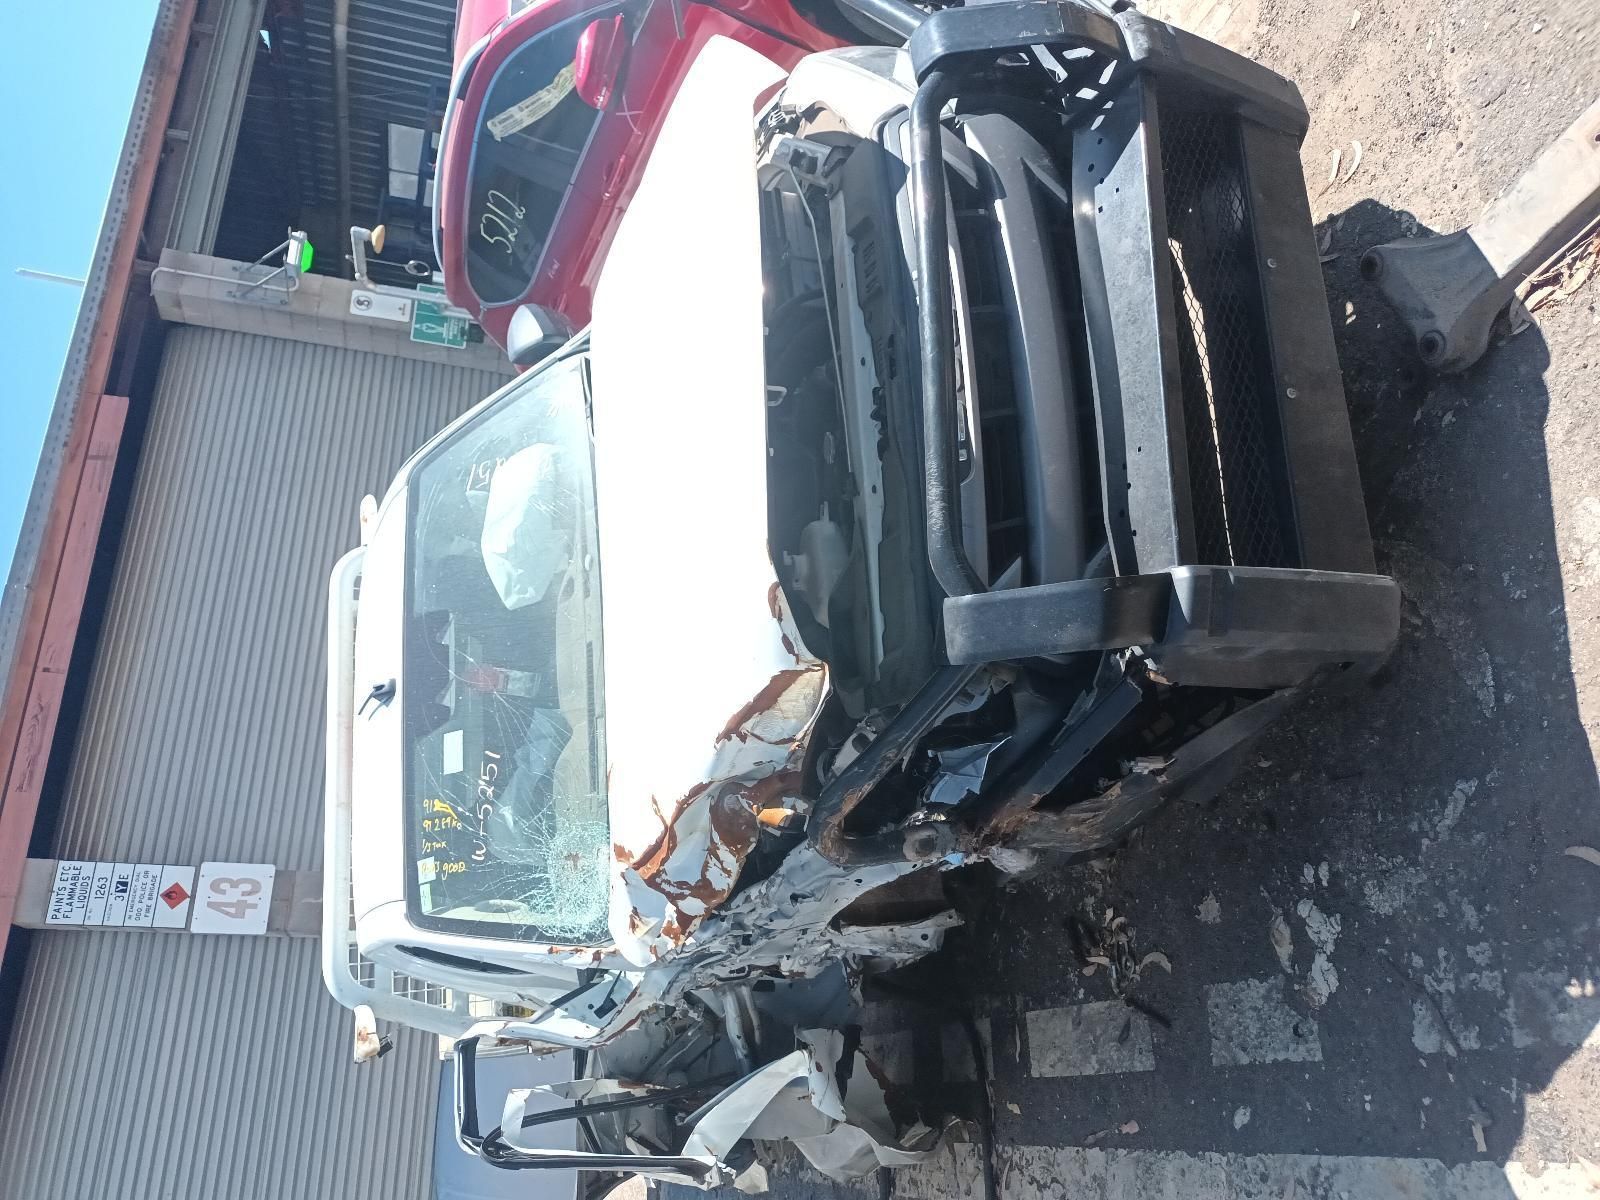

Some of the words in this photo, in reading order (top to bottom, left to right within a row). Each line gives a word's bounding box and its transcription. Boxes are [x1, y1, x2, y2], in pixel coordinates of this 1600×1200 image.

[480, 190, 526, 253] 5212
[94, 877, 108, 899] 1263
[142, 870, 150, 878] OR
[147, 874, 157, 900] BRIGADE
[51, 886, 66, 920] PAINTS
[62, 866, 82, 918] FLAMMABLE
[75, 876, 90, 909] LIQUIDS
[138, 882, 147, 904] POLICE
[206, 877, 262, 919] 43
[144, 904, 152, 918] FIRE
